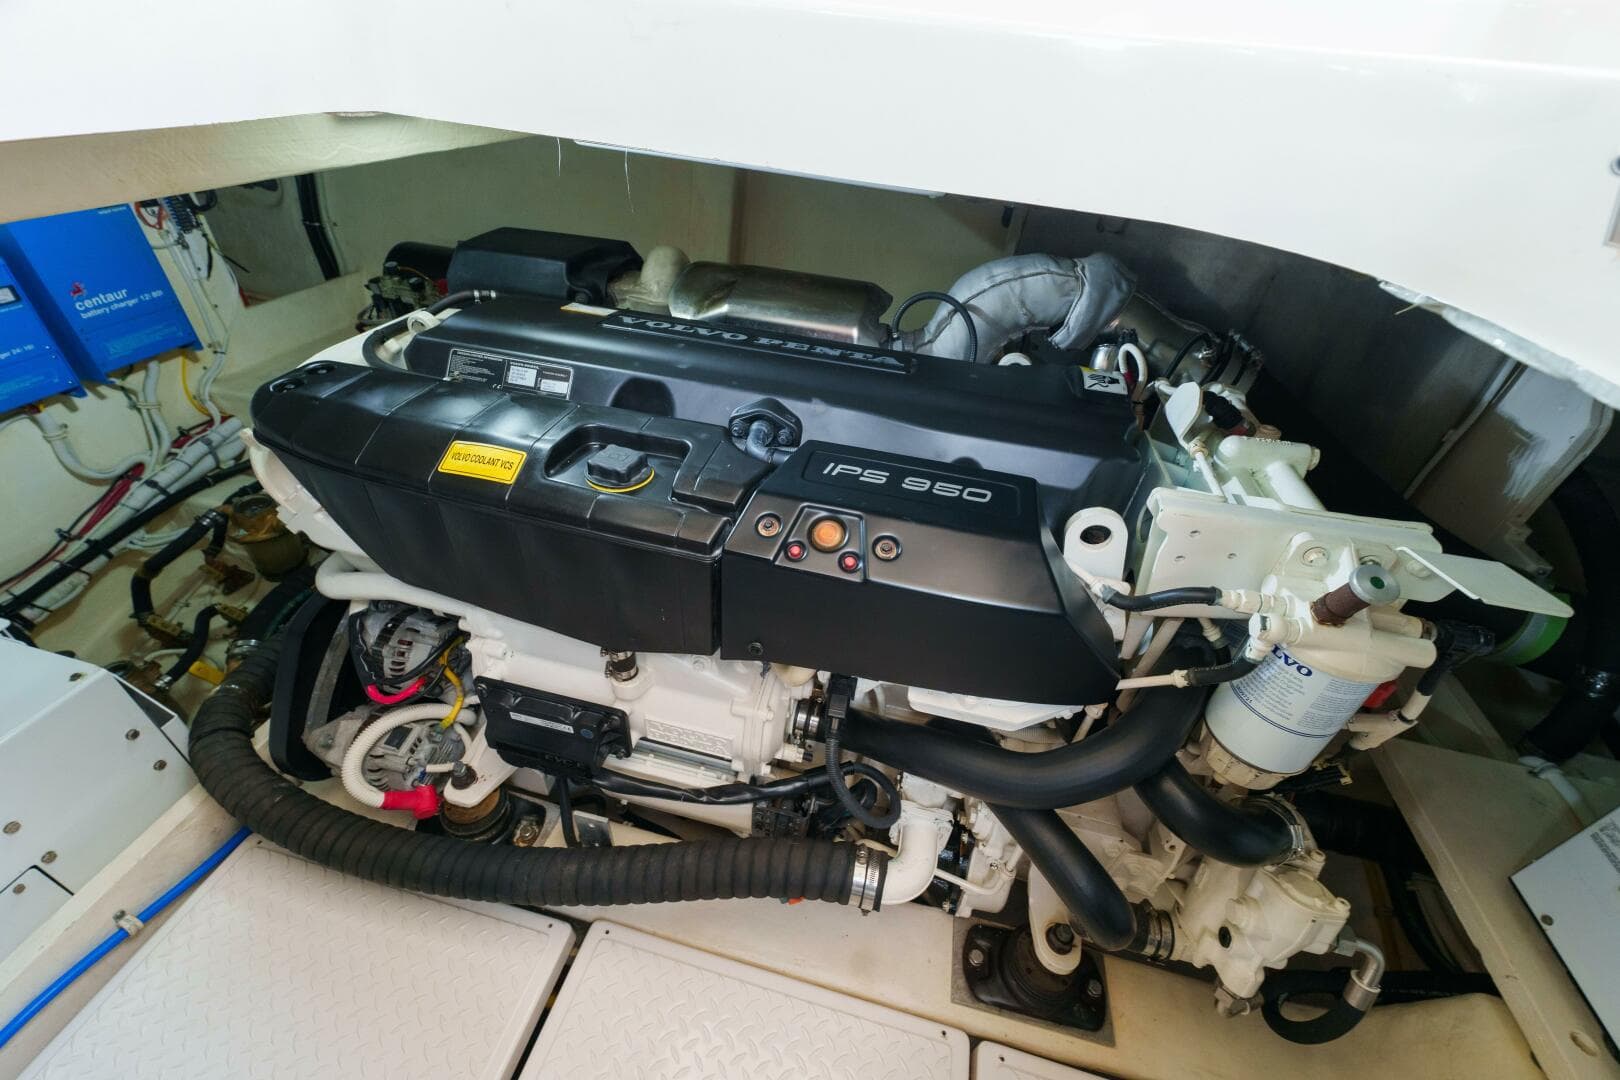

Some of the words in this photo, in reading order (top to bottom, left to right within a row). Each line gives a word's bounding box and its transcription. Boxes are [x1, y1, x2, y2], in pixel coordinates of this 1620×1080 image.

[80, 307, 110, 319] battery
[110, 298, 138, 312] charger
[616, 315, 750, 341] VOLVO
[752, 336, 906, 367] PENTA
[451, 452, 471, 462] VOLVO
[470, 454, 501, 467] COOLANT
[500, 460, 515, 470] VCS
[822, 461, 890, 485] IPS
[901, 476, 993, 503] 950
[1271, 644, 1313, 677] LVO
